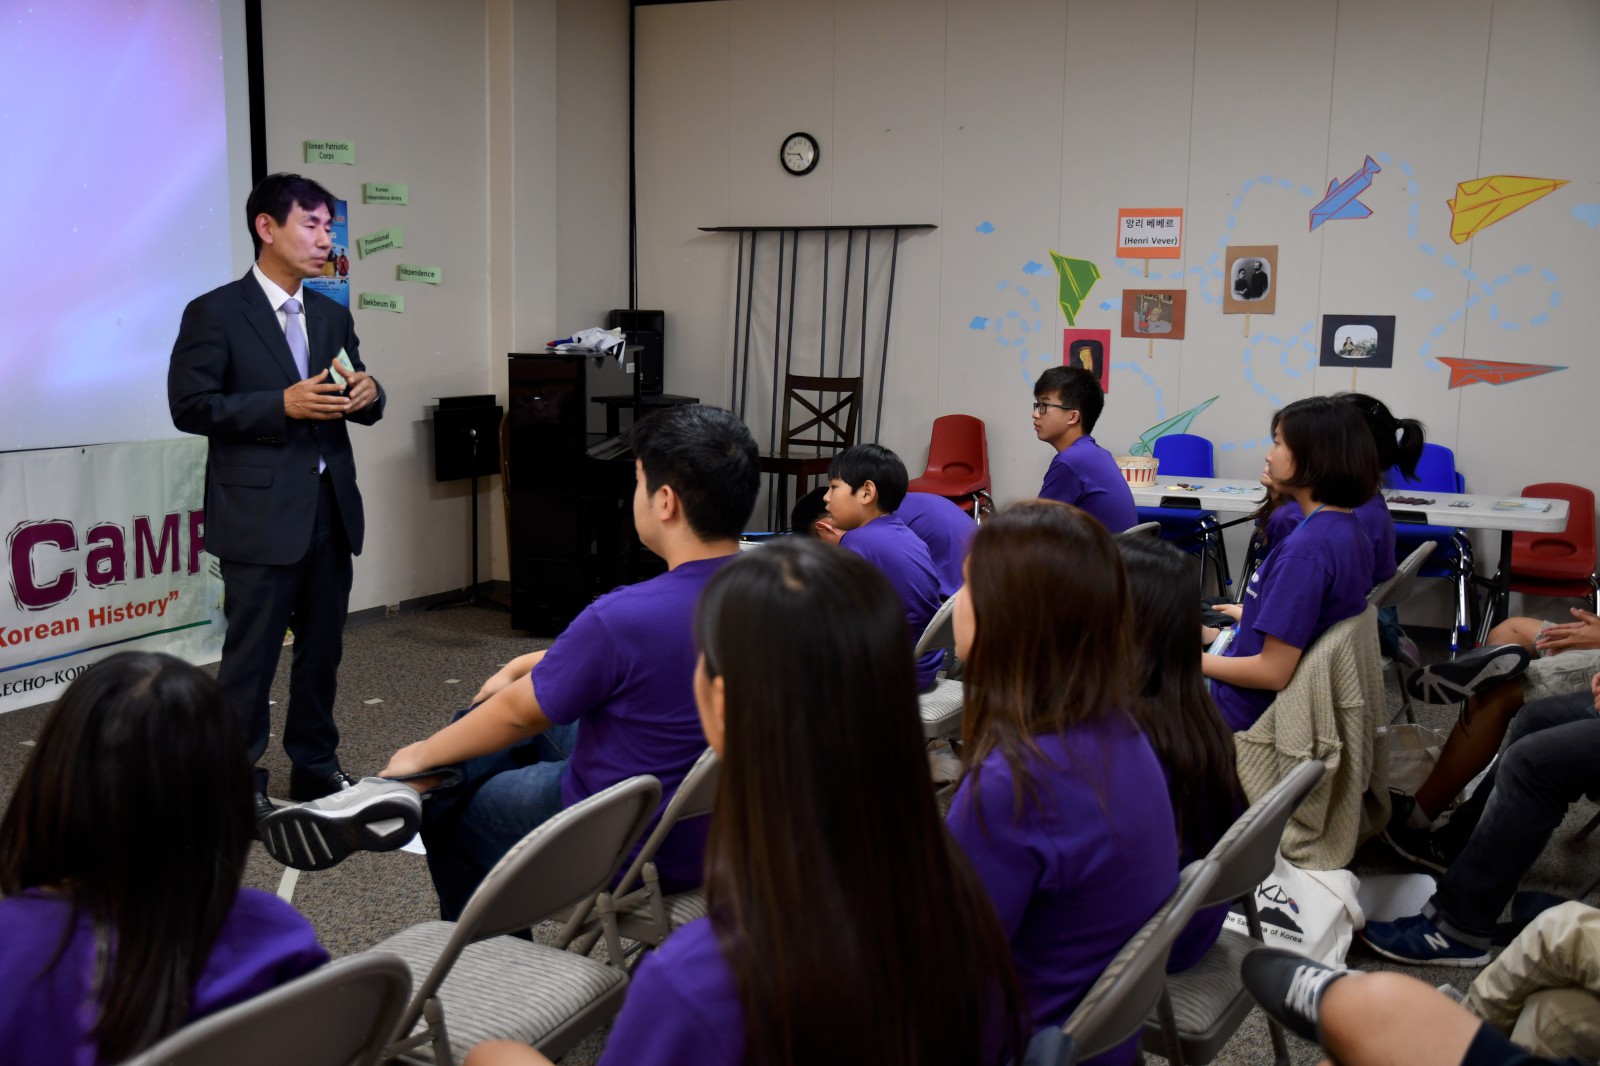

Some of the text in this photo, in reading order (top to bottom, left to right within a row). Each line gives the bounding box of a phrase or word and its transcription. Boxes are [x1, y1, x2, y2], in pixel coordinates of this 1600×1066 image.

[325, 142, 349, 151] Patriotic
[319, 152, 335, 160] Corps
[1126, 218, 1174, 228] 앙리 베베르
[364, 233, 390, 246] Provisional
[1124, 236, 1177, 246] (Henri Vever)
[364, 240, 394, 255] Government
[1280, 931, 1302, 943] Korea
[1423, 932, 1450, 950] N
